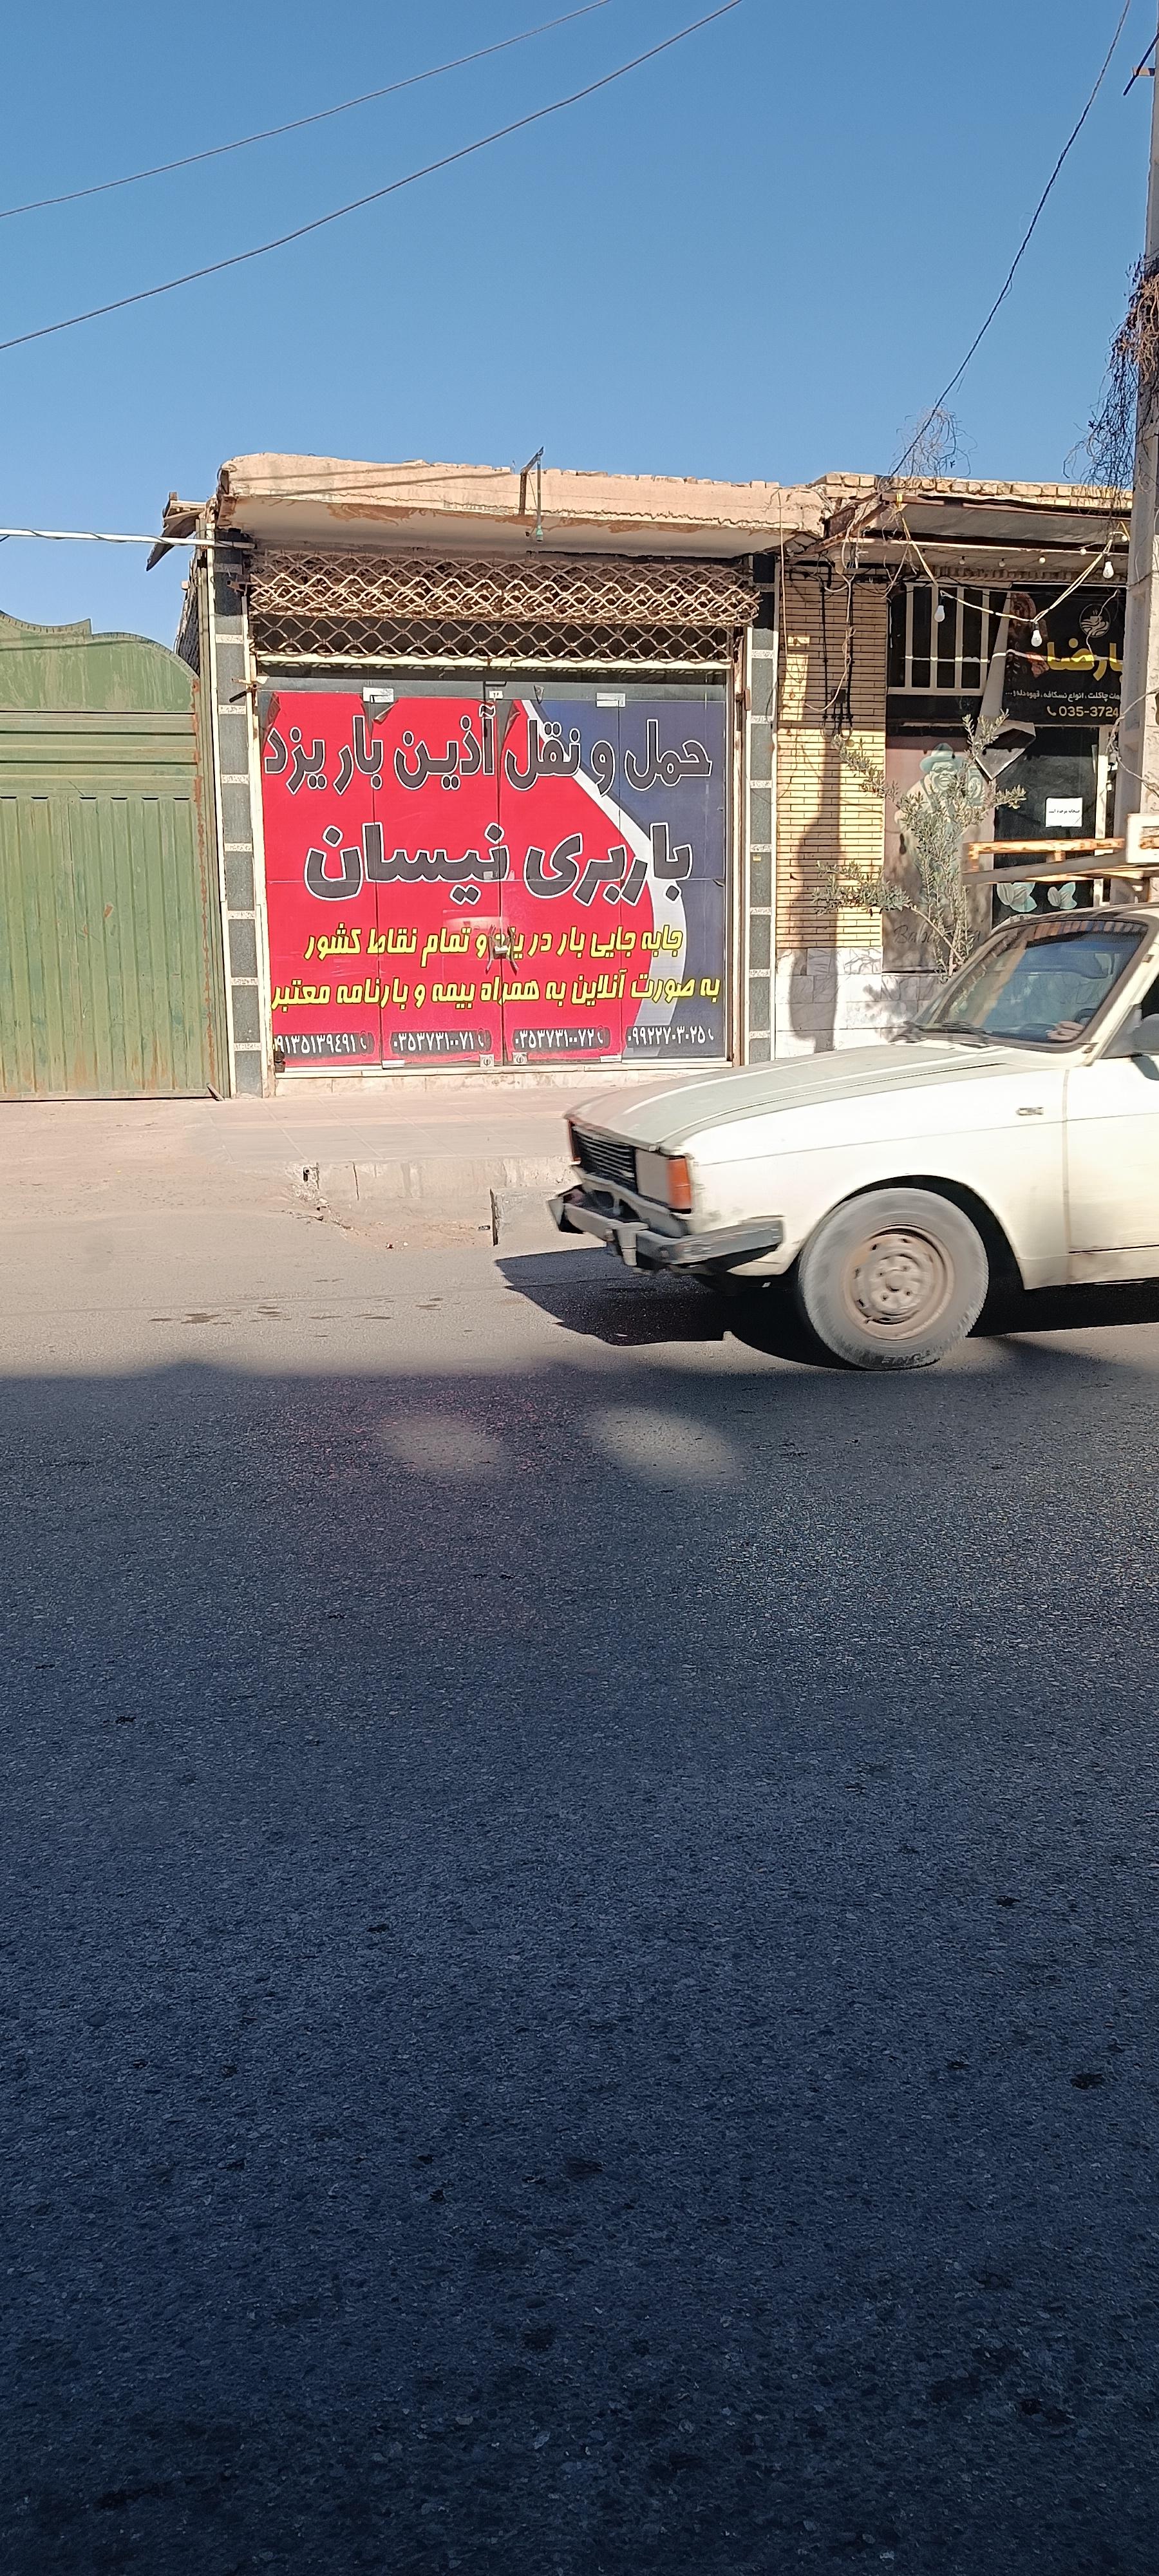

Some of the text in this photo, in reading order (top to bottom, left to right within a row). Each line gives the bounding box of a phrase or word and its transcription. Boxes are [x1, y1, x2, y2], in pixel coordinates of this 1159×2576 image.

[1068, 692, 1084, 703] انواع
[265, 704, 713, 797] حمل و نقل آذین بار یزد
[304, 822, 692, 906] باربری نیسان
[303, 922, 362, 961] کشور
[366, 928, 418, 954] نقاط
[420, 927, 471, 968] تمام
[476, 933, 487, 959] و
[527, 931, 552, 957] در
[556, 925, 586, 958] بار
[590, 925, 637, 958] جایی
[641, 925, 683, 958] جابه
[270, 969, 721, 1012] به صورت آنلاین به همراه بیمه و بارنامه معتبر
